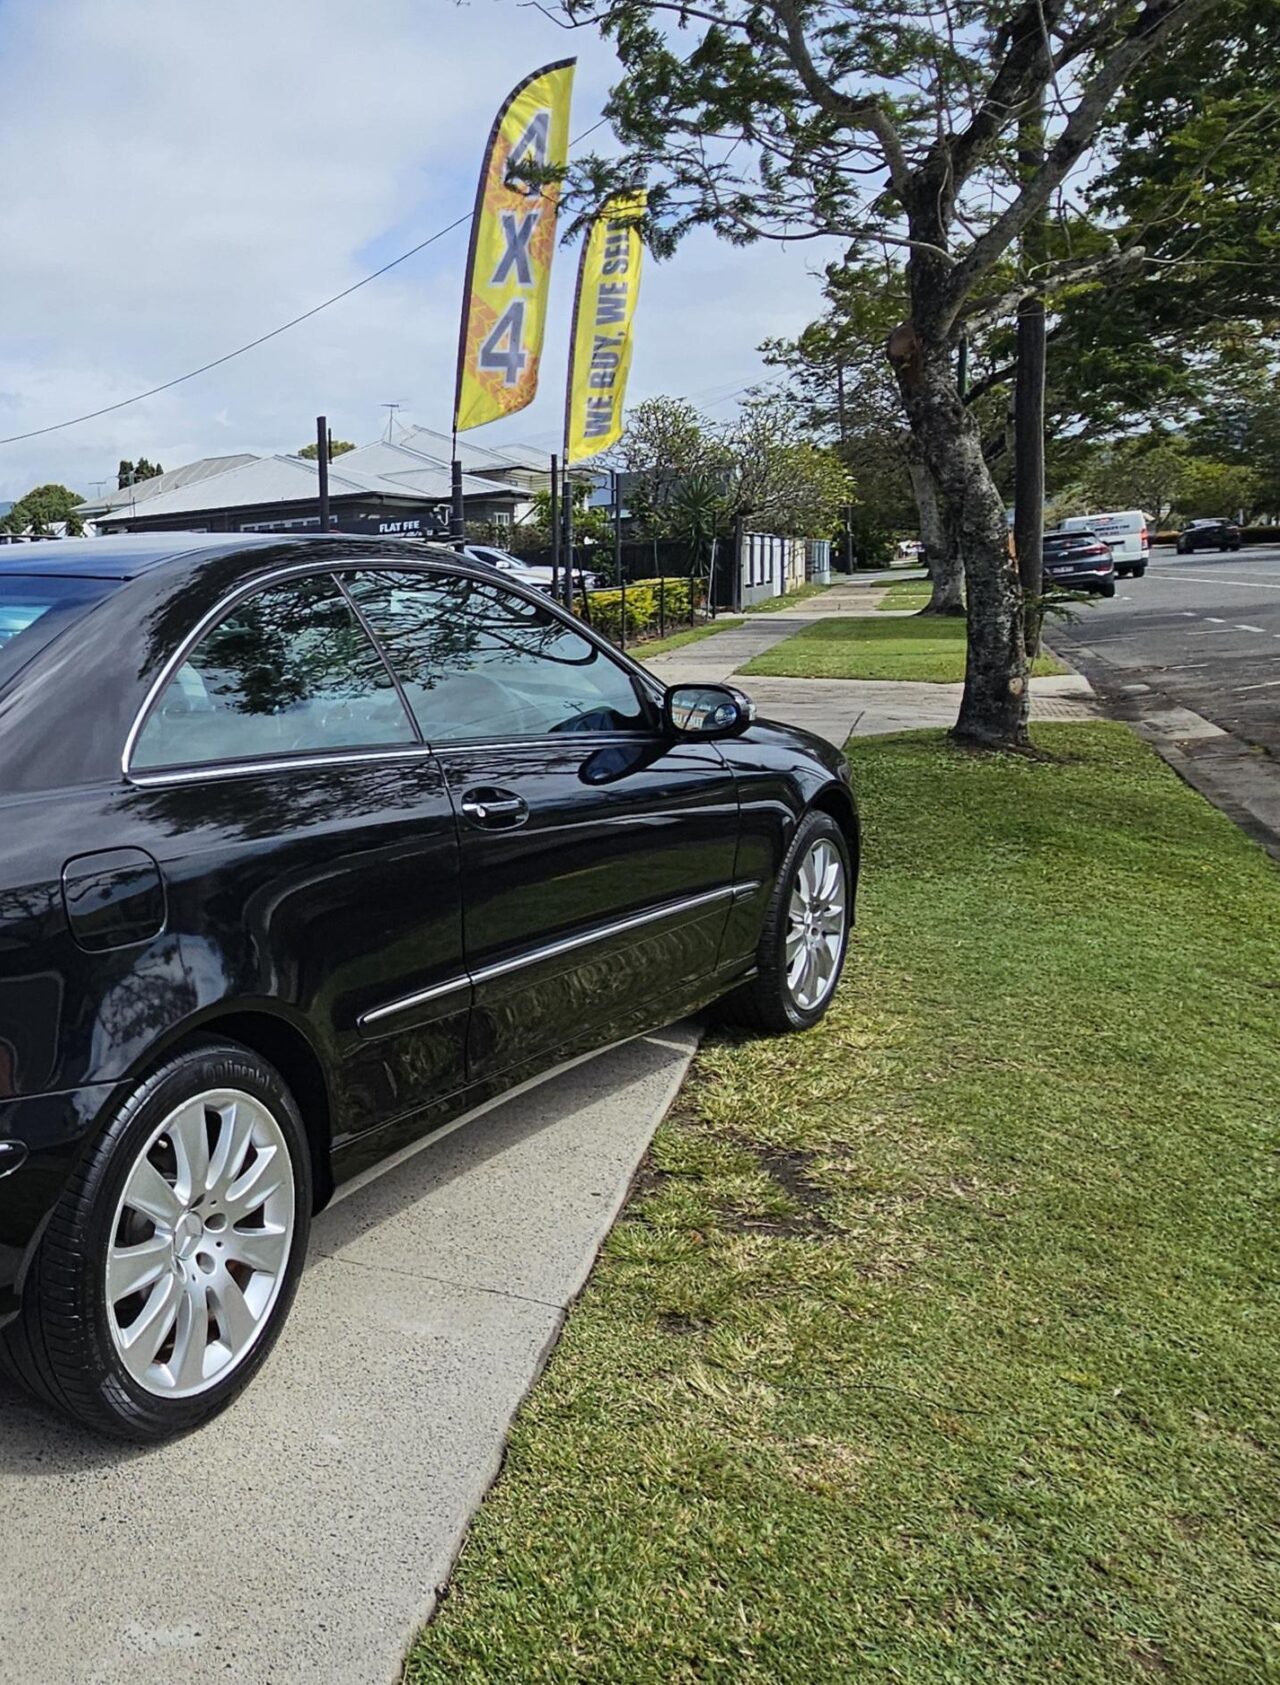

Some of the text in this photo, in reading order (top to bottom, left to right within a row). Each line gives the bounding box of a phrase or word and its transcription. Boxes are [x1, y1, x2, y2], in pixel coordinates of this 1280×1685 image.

[596, 281, 628, 326] WE
[584, 396, 613, 438] WE
[379, 520, 420, 533] FLAT FEE
